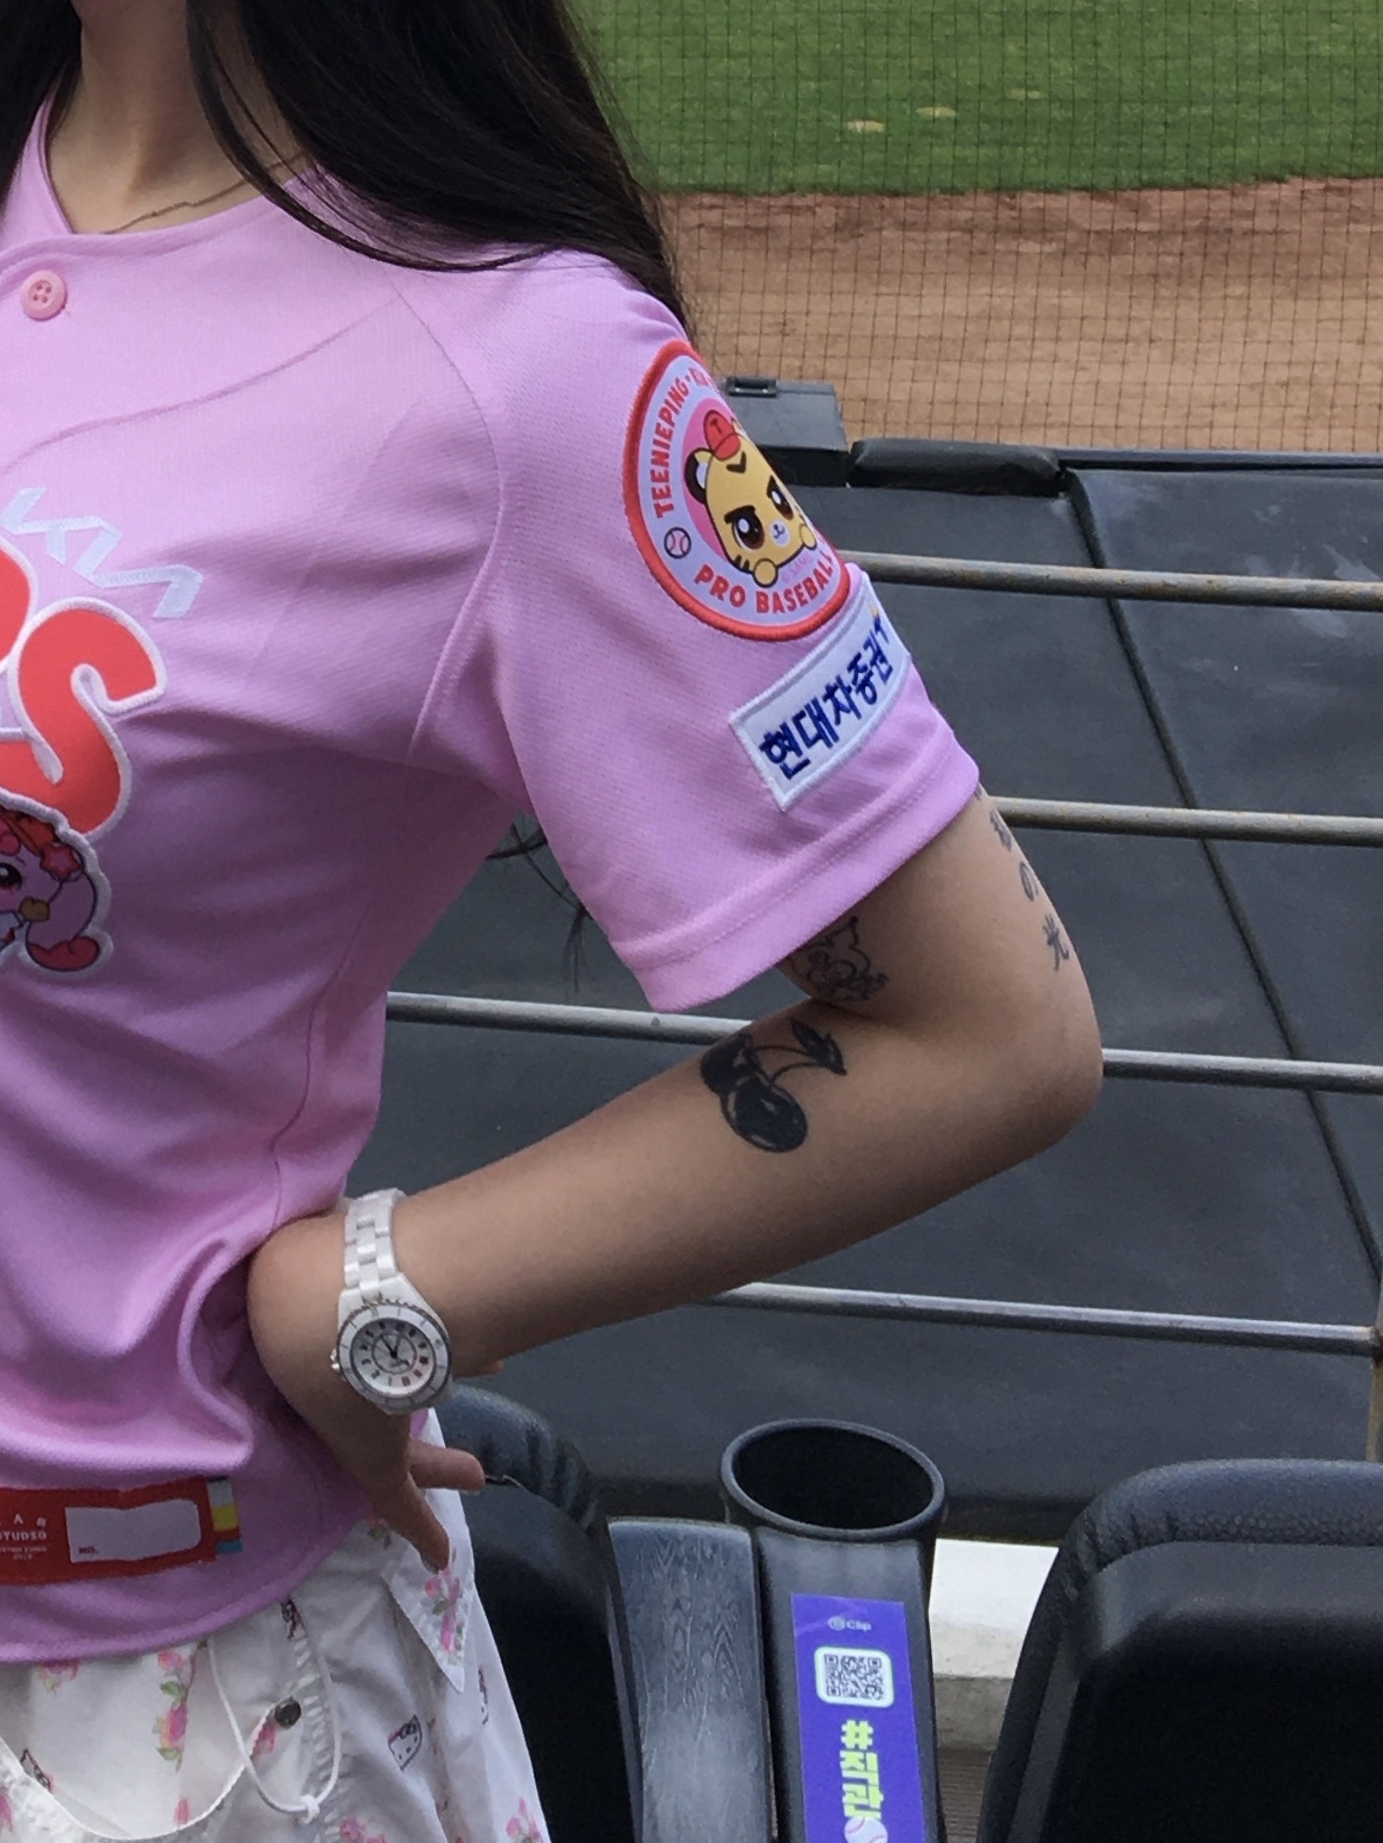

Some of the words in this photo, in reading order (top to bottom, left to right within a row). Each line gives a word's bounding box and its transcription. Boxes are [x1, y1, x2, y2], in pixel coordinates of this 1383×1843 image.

[650, 375, 691, 519] TEENIEPING
[694, 564, 746, 607] PRO
[759, 628, 893, 780] 현대차증권
